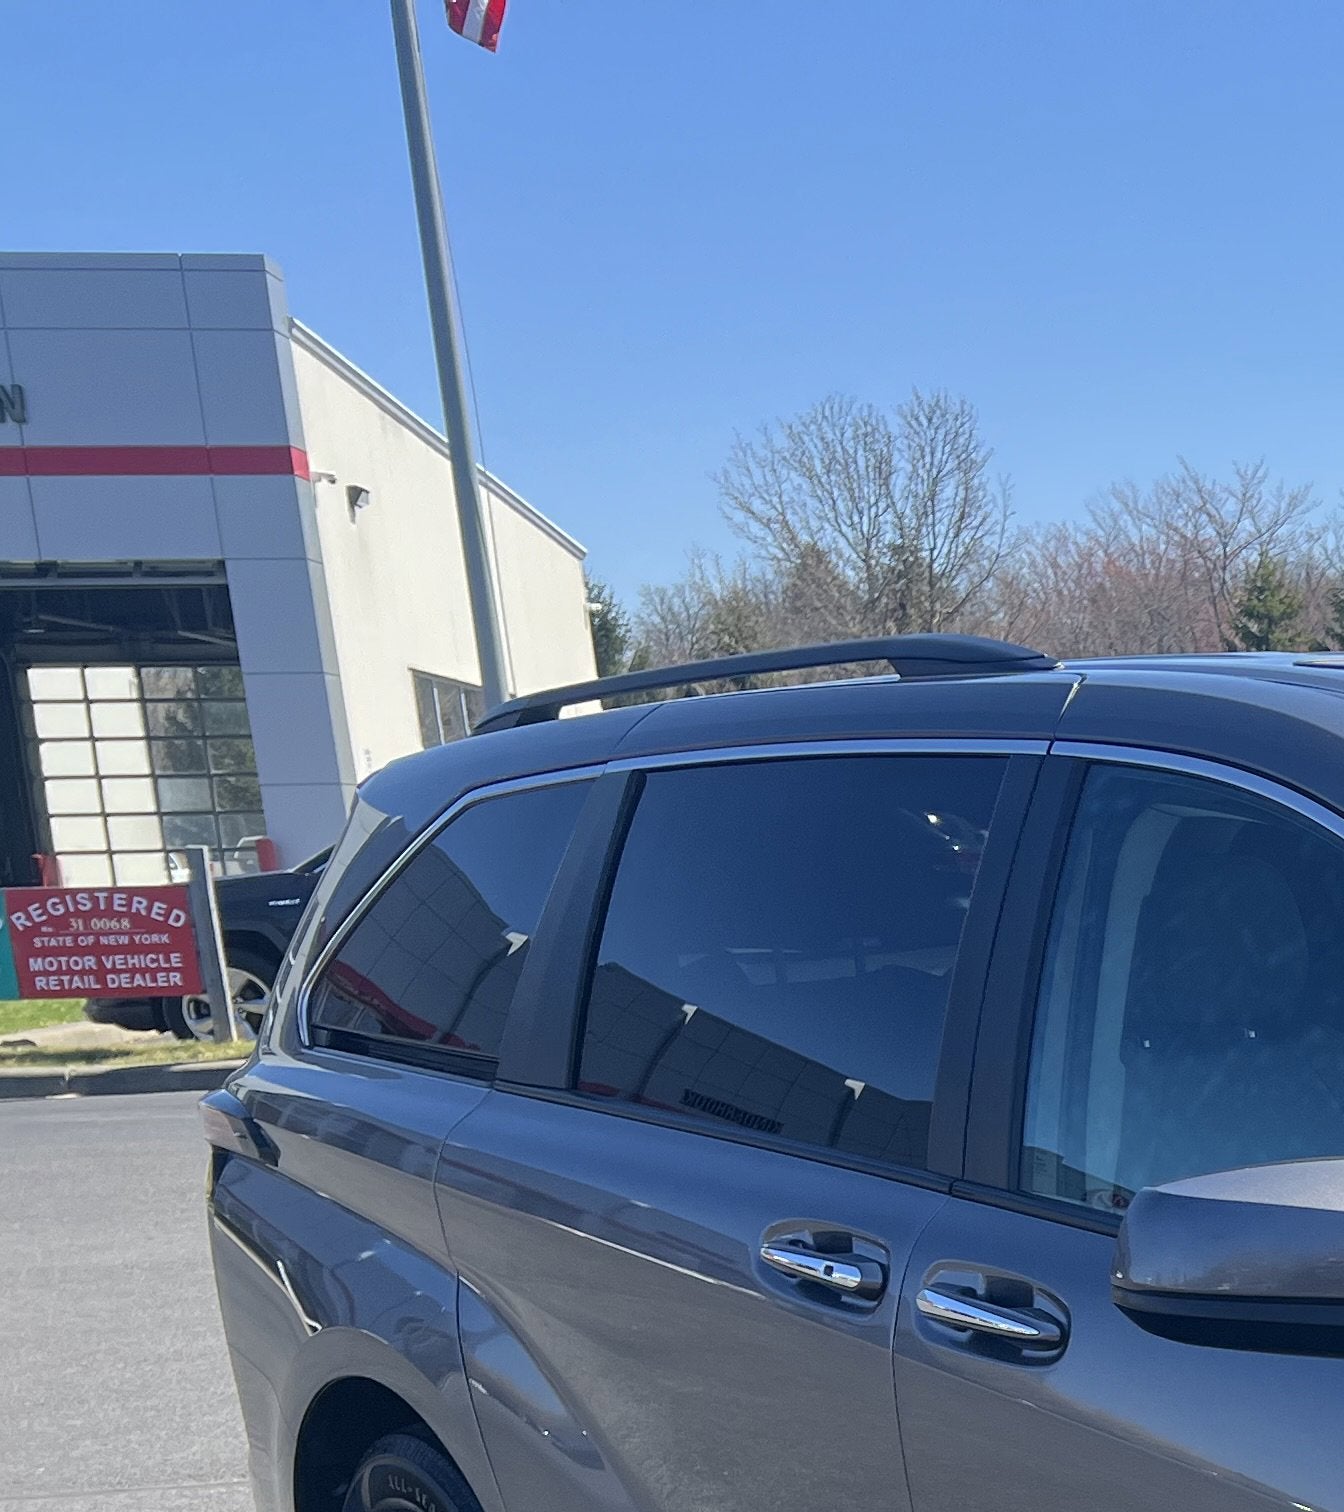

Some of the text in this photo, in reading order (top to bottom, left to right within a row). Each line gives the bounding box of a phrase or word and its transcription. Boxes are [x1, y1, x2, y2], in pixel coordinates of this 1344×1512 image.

[10, 892, 187, 931] REGISTERED
[90, 918, 131, 930] 0068
[33, 933, 170, 948] STATE OF NEW YORK
[28, 953, 184, 972] MOTOR VEHICLE
[35, 972, 184, 991] RETAIL DEALER
